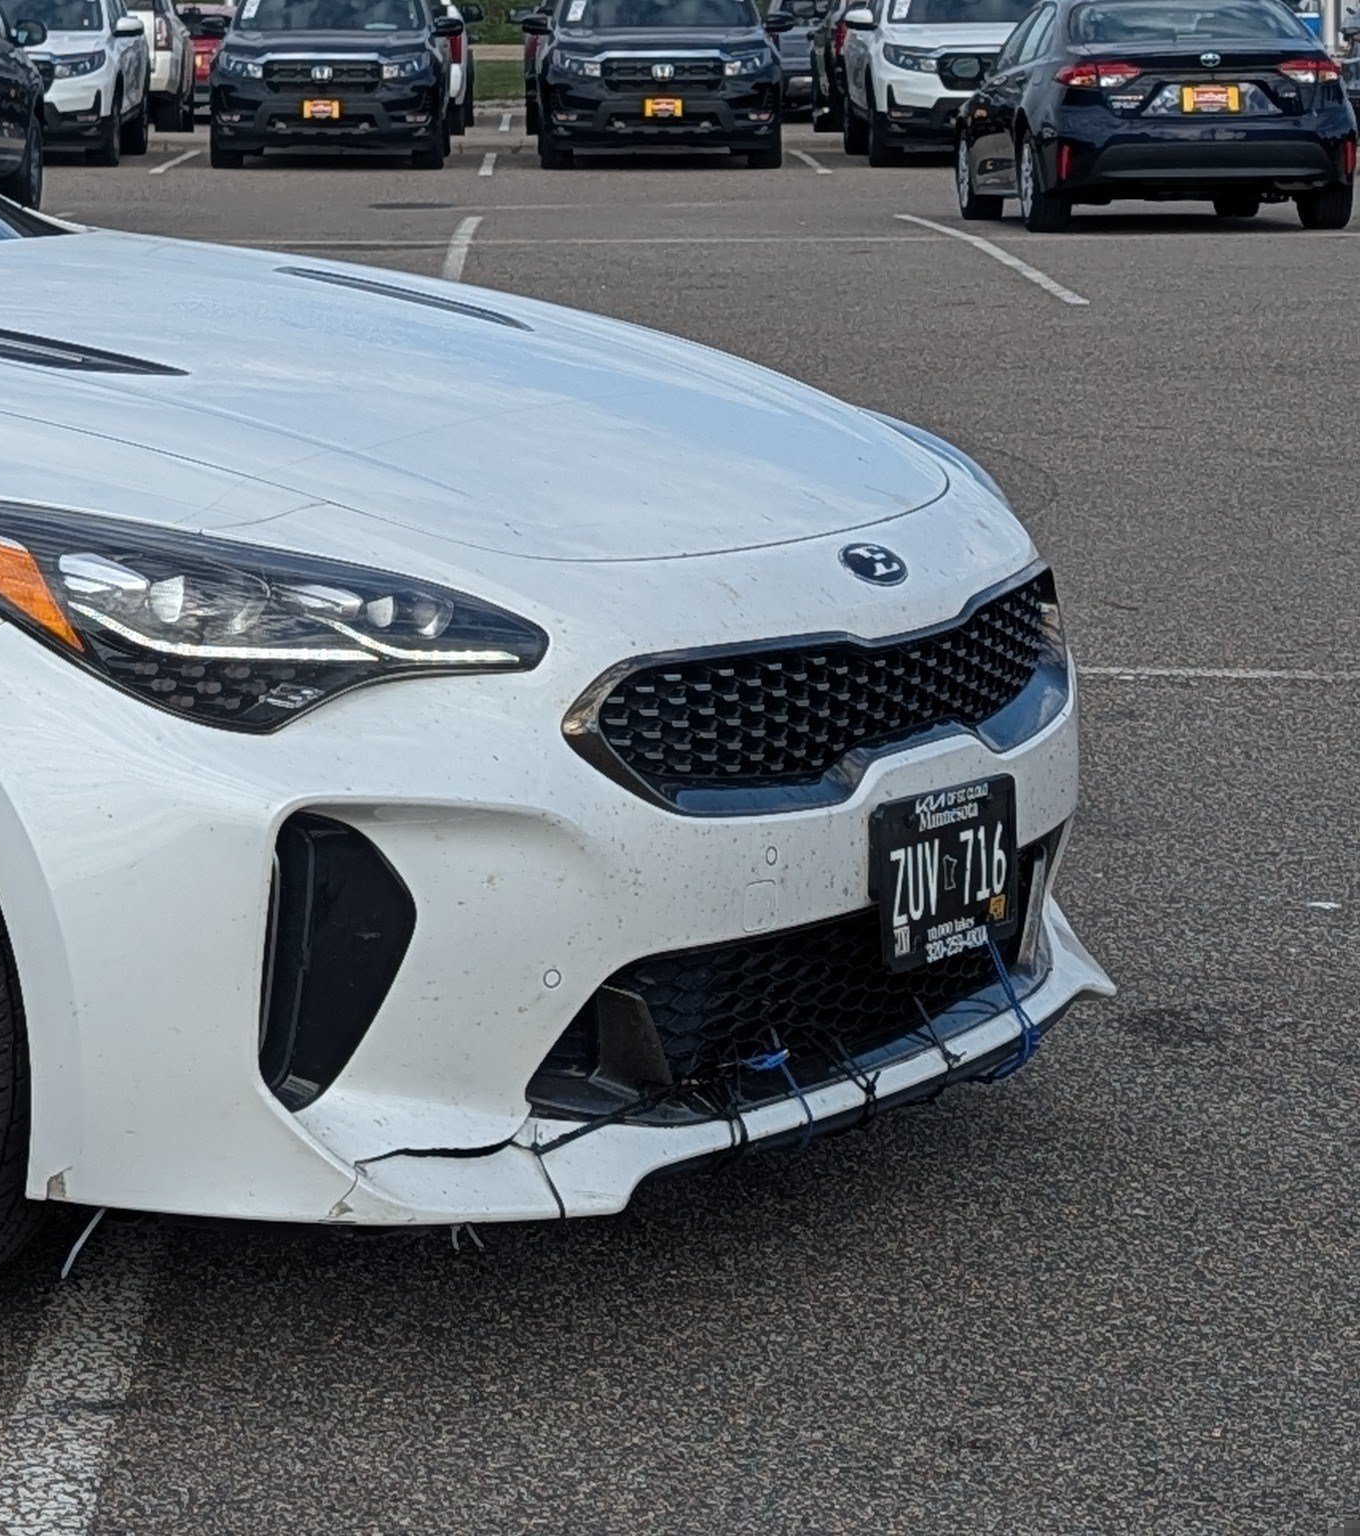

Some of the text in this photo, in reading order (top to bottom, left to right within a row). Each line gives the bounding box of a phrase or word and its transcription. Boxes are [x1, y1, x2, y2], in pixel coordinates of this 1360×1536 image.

[919, 802, 979, 833] Minnesota
[890, 821, 1007, 927] ZUV 716
